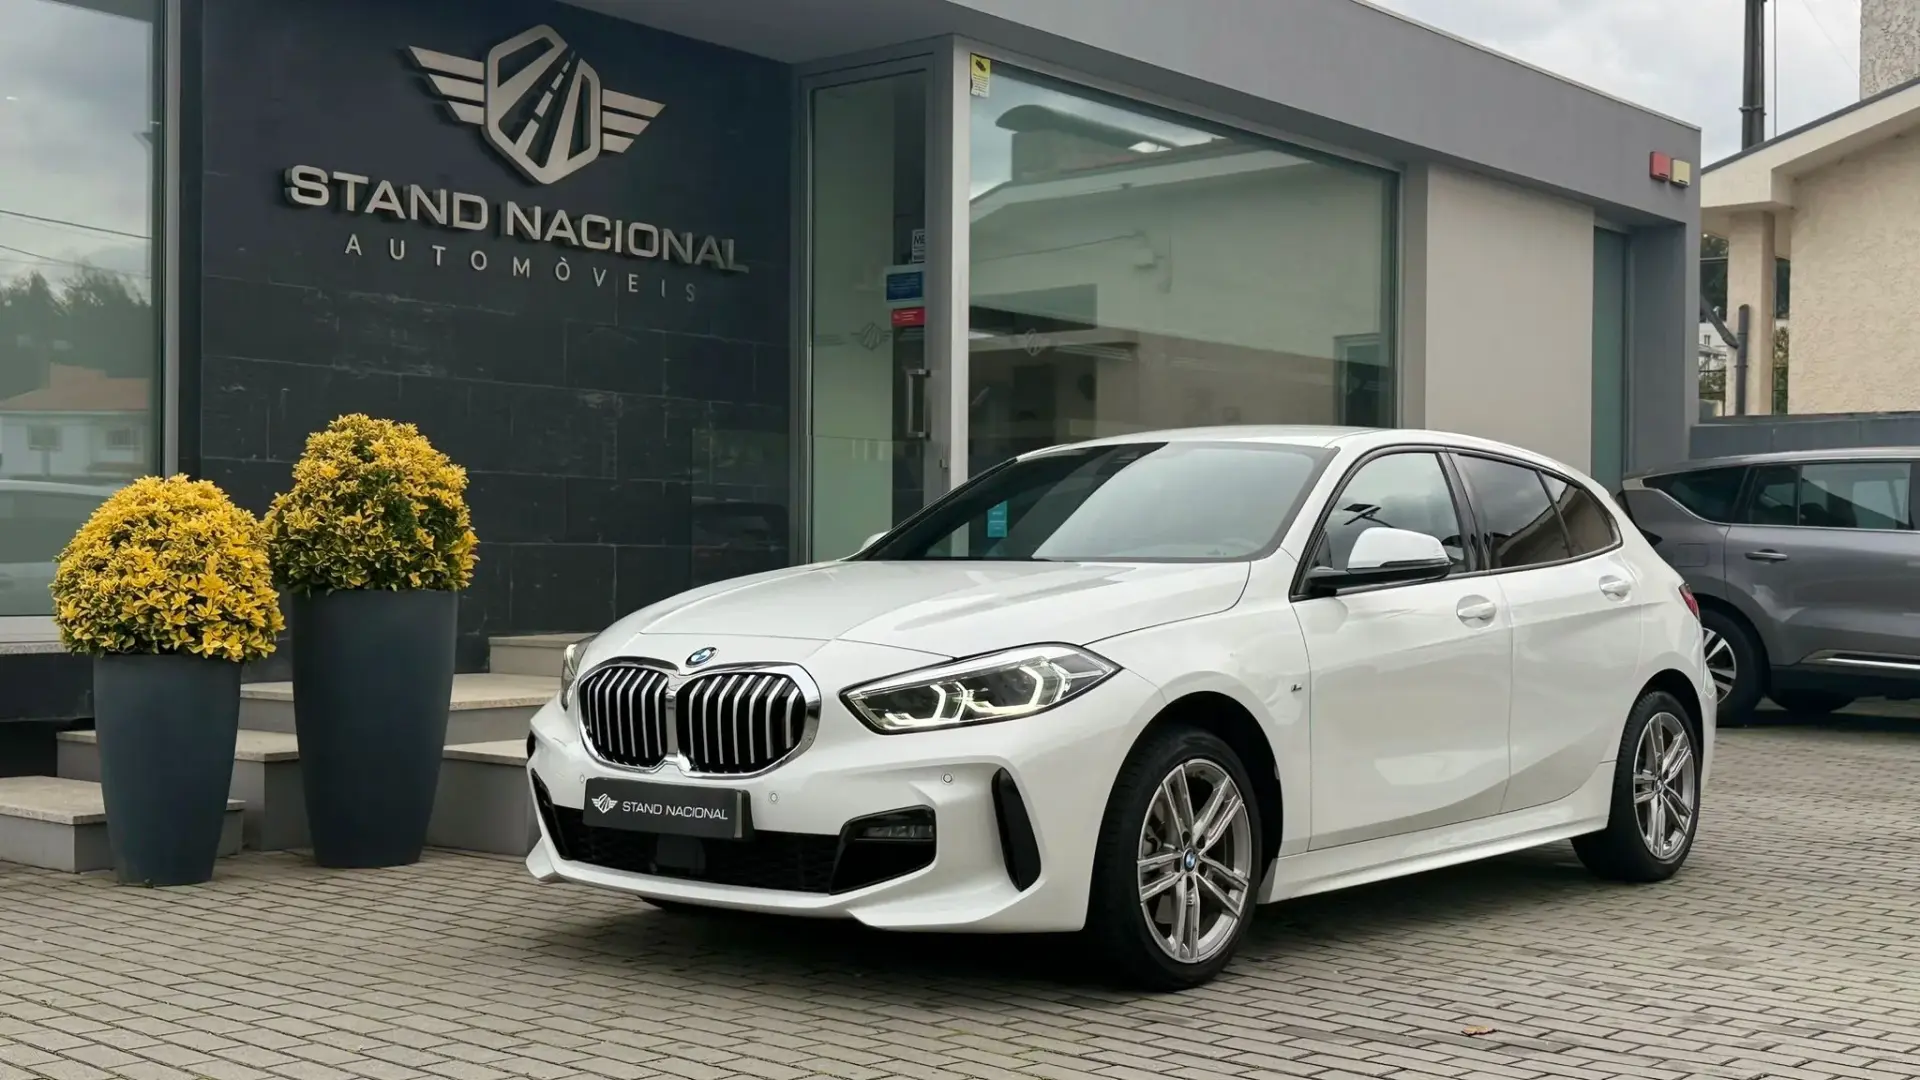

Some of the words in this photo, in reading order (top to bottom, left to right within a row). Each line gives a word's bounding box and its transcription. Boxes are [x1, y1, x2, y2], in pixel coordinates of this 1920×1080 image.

[286, 164, 488, 232] STAND
[506, 200, 749, 272] NACIONAL
[344, 233, 696, 302] AUTOMÒVEIS
[622, 801, 662, 815] STAND
[665, 804, 728, 820] NACIONAL
